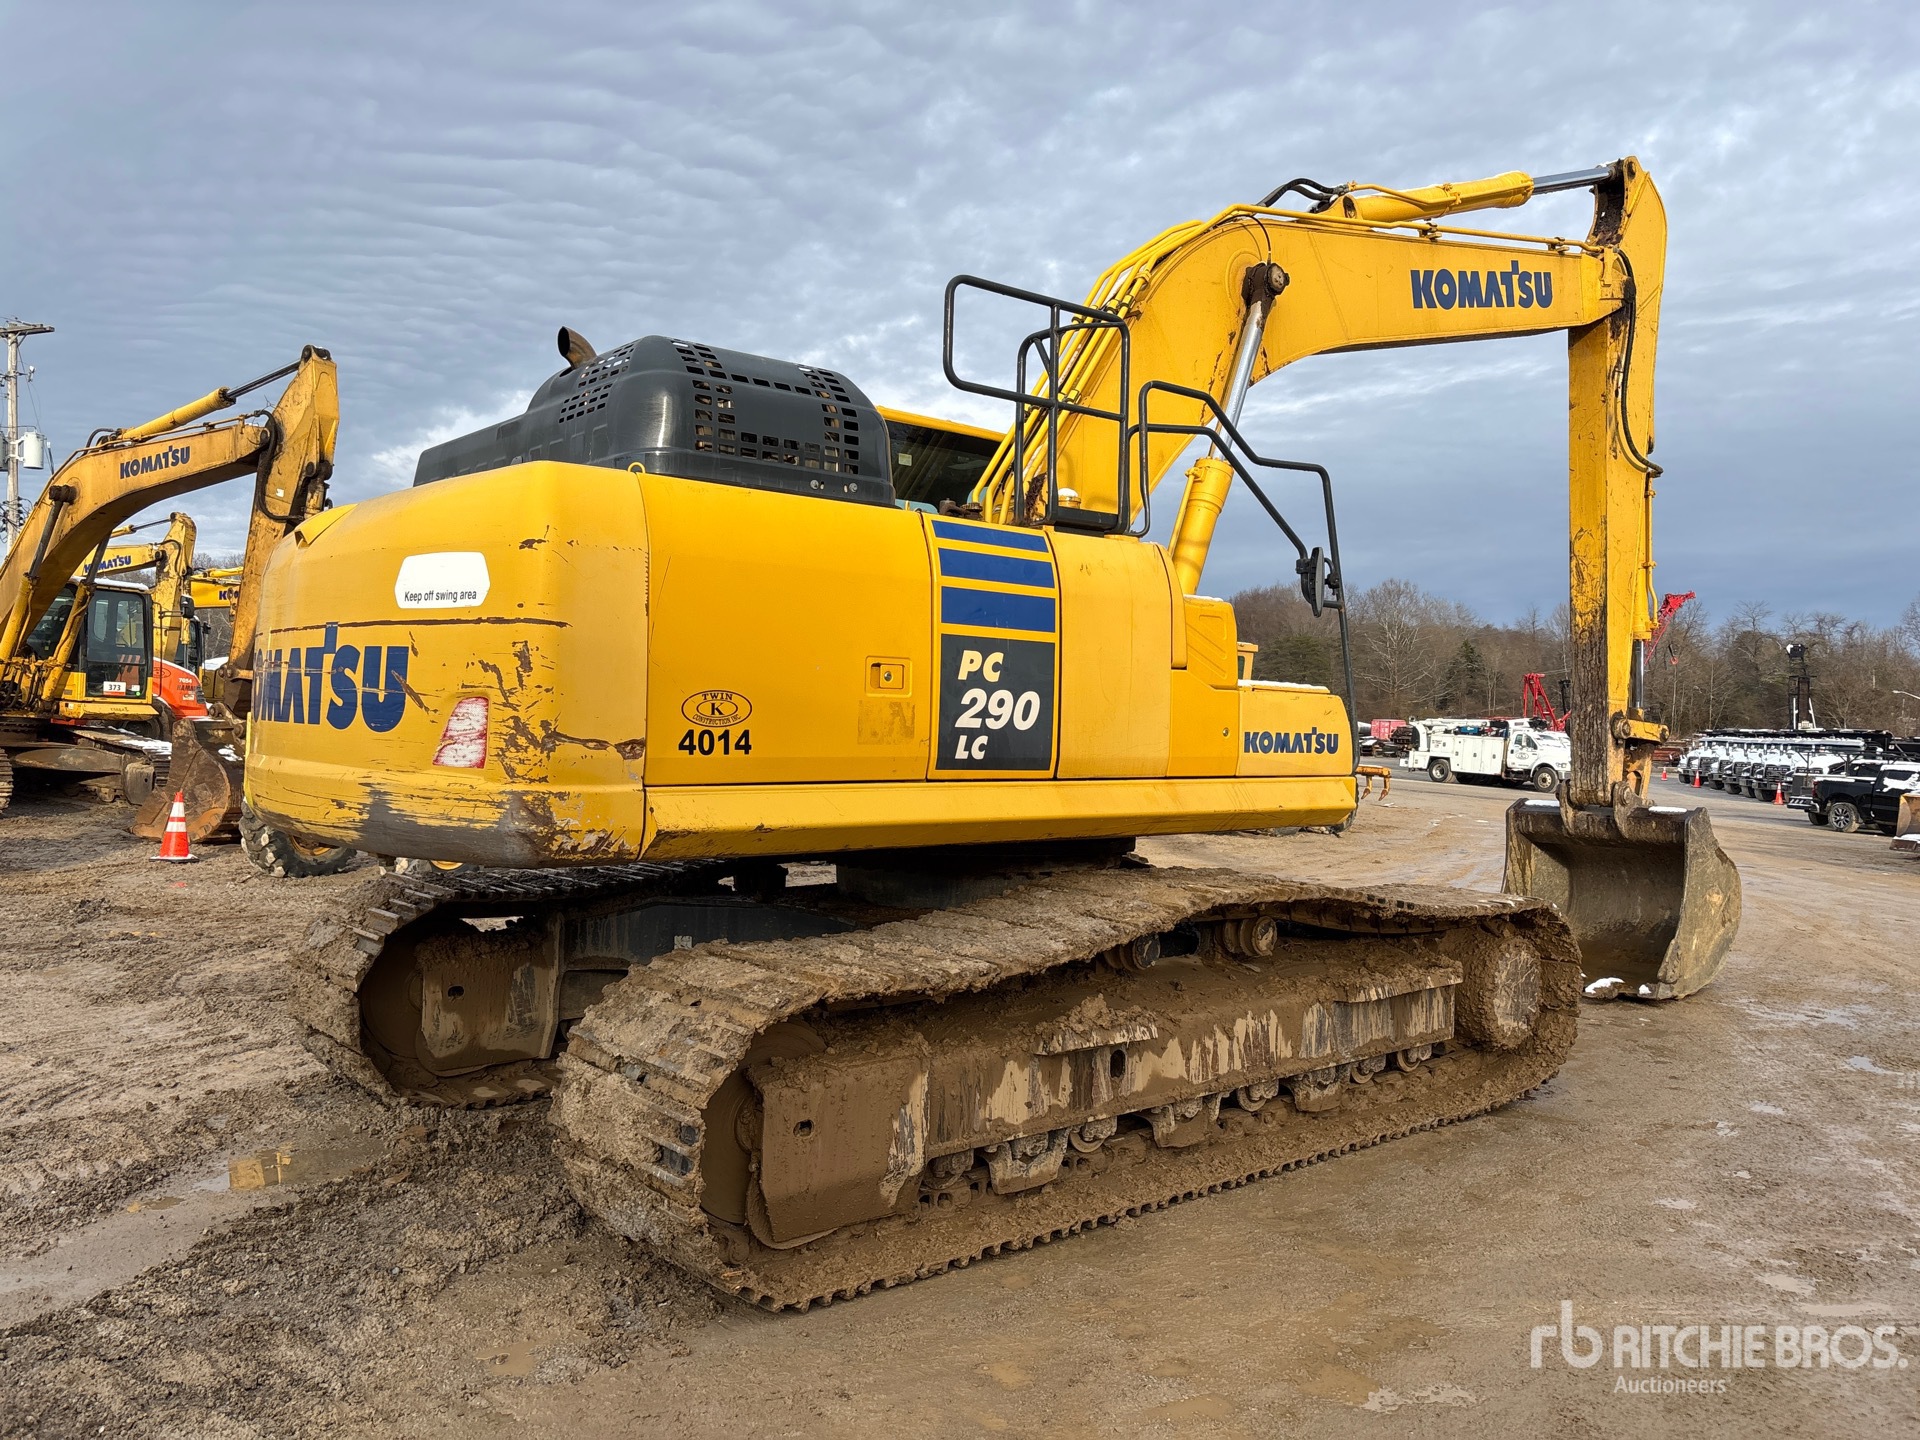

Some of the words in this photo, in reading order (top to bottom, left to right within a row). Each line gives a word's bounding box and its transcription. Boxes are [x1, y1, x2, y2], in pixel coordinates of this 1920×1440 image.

[1410, 260, 1553, 310] KOMATSU
[120, 445, 190, 479] KOMATSU
[84, 555, 131, 573] KMATSU
[404, 591, 422, 604] Keep
[424, 590, 434, 601] off
[435, 590, 458, 603] swing
[460, 590, 477, 600] area
[253, 622, 409, 733] OMATSU
[958, 650, 1004, 683] PC
[692, 714, 730, 725] CONSTRUCTION
[711, 702, 724, 715] K
[955, 688, 1040, 731] 290
[678, 729, 752, 756] 4014
[955, 735, 988, 760] LC
[1244, 727, 1339, 754] KOMATSU
